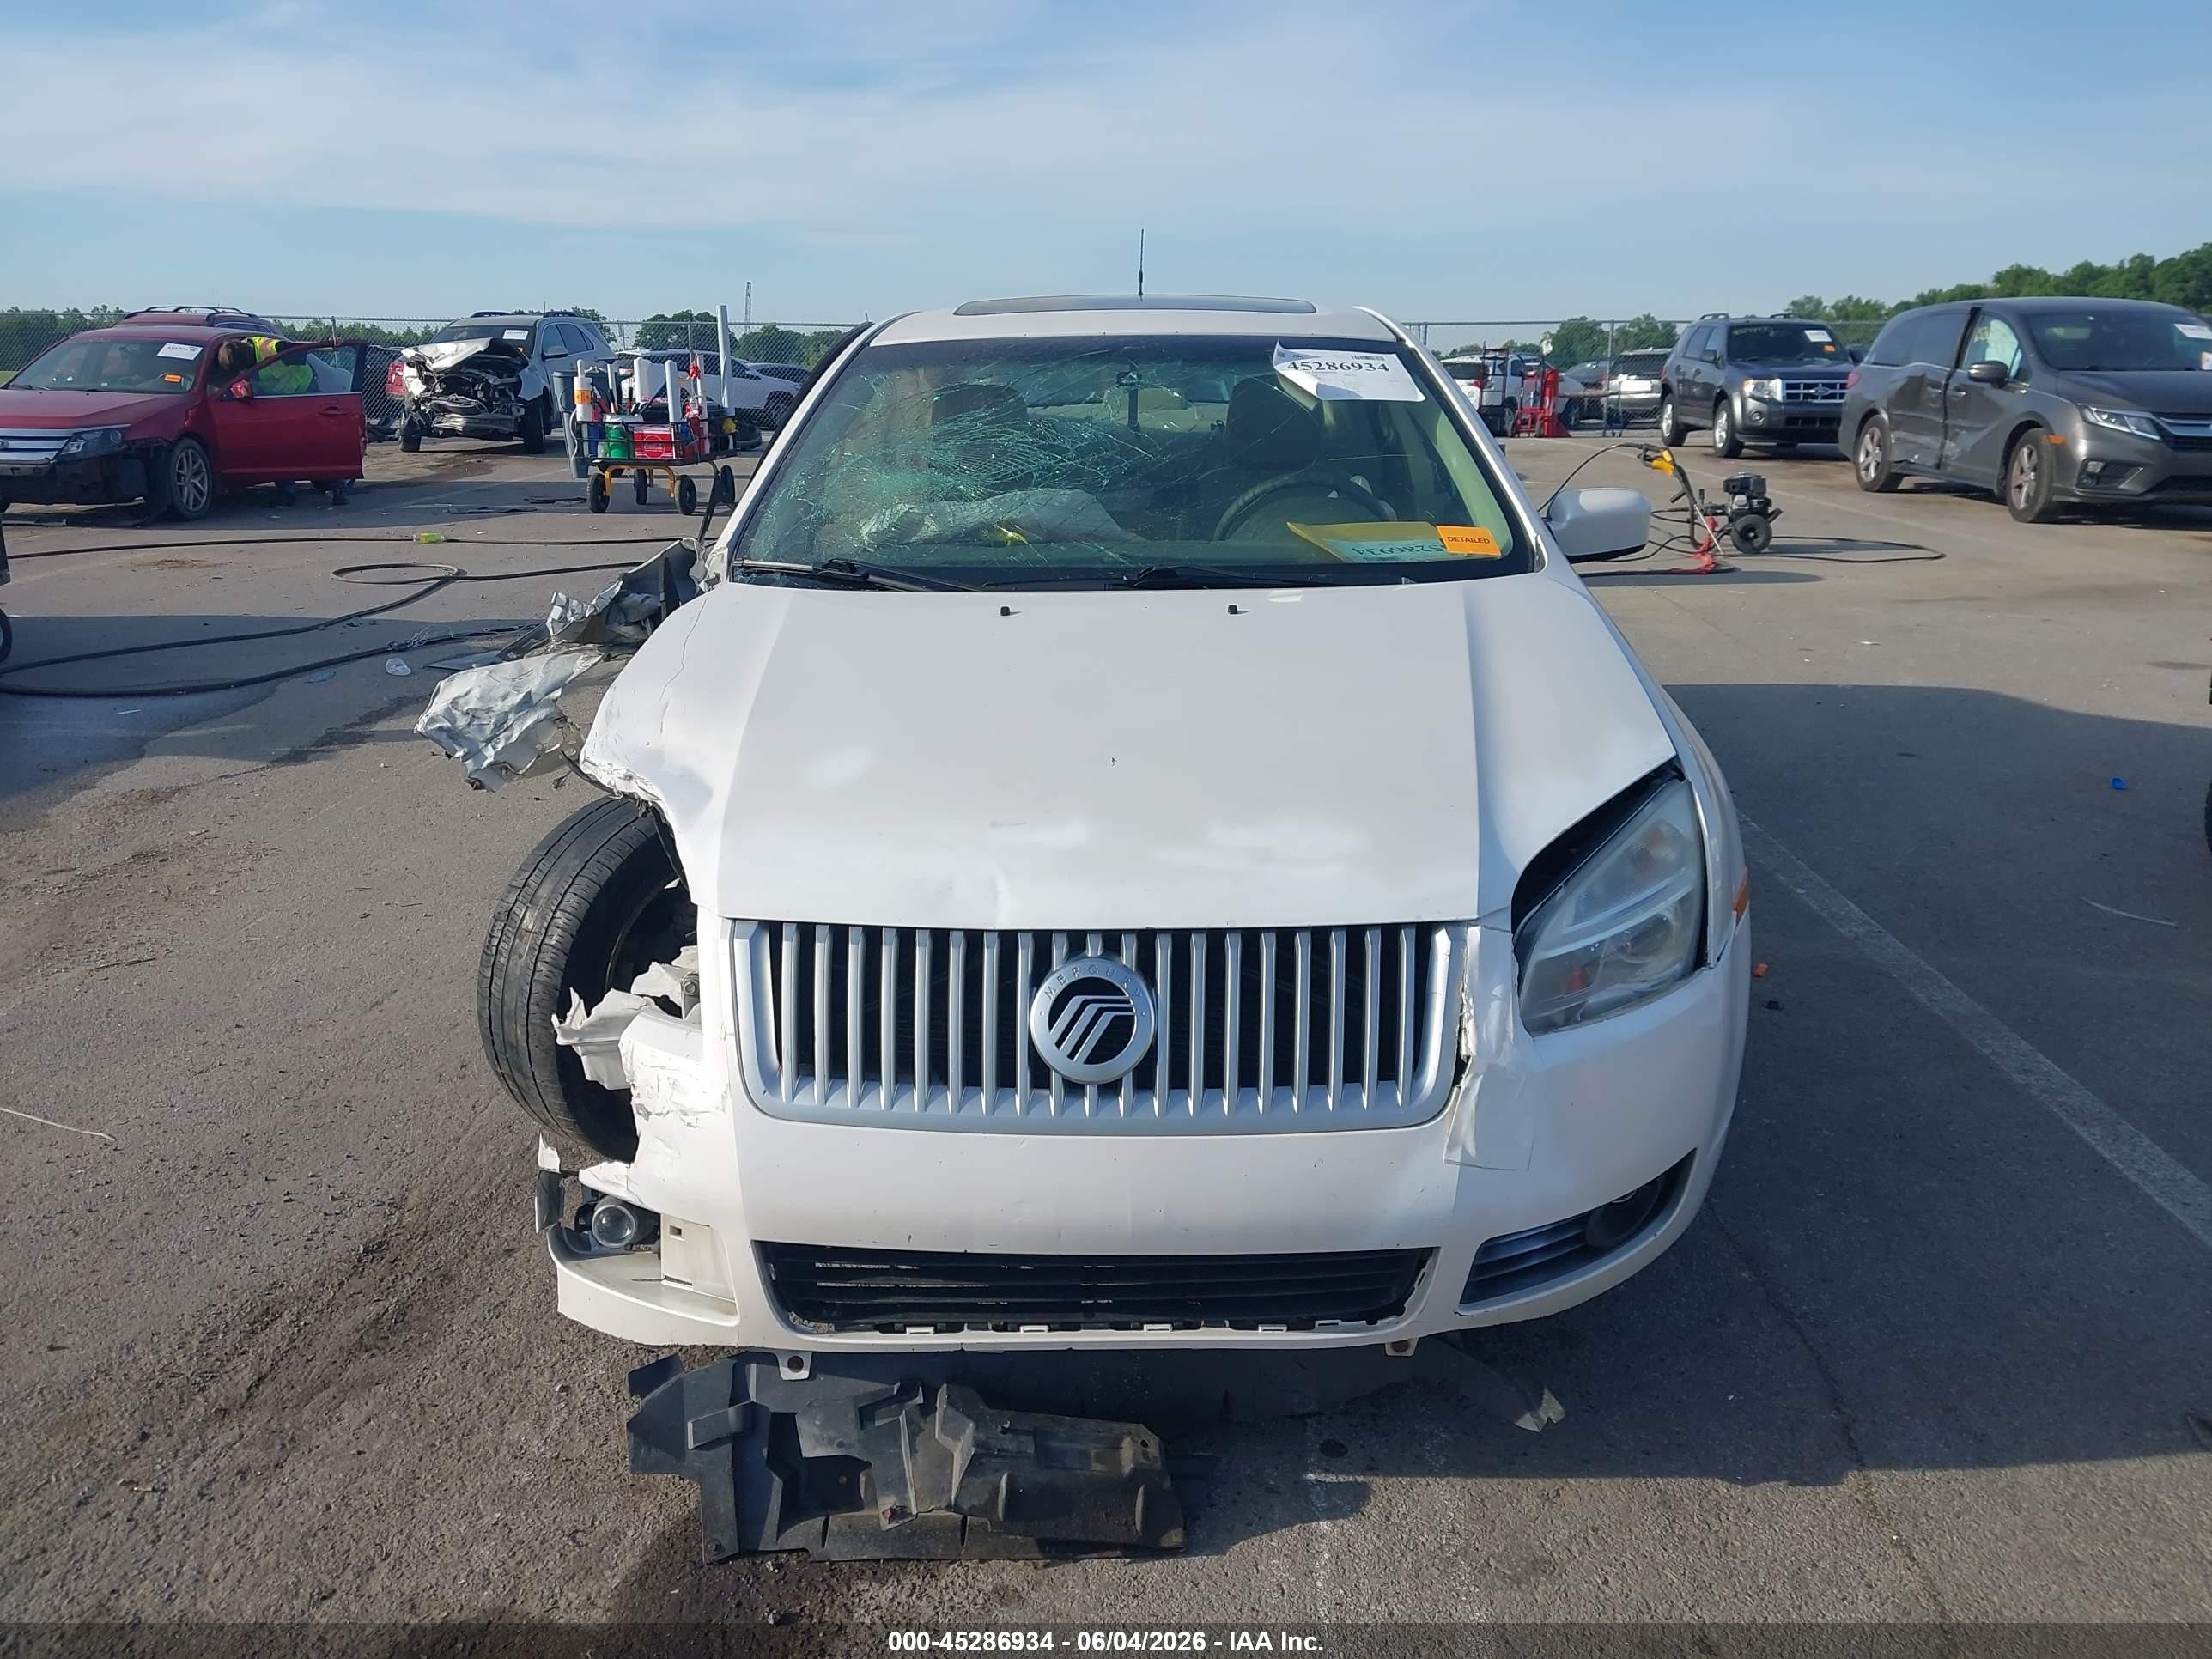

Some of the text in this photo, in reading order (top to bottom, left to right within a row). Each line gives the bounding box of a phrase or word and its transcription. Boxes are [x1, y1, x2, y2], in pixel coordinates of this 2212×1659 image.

[1288, 361, 1389, 372] 45286934
[1446, 536, 1491, 544] DETAILED
[1352, 544, 1444, 556] 5286934
